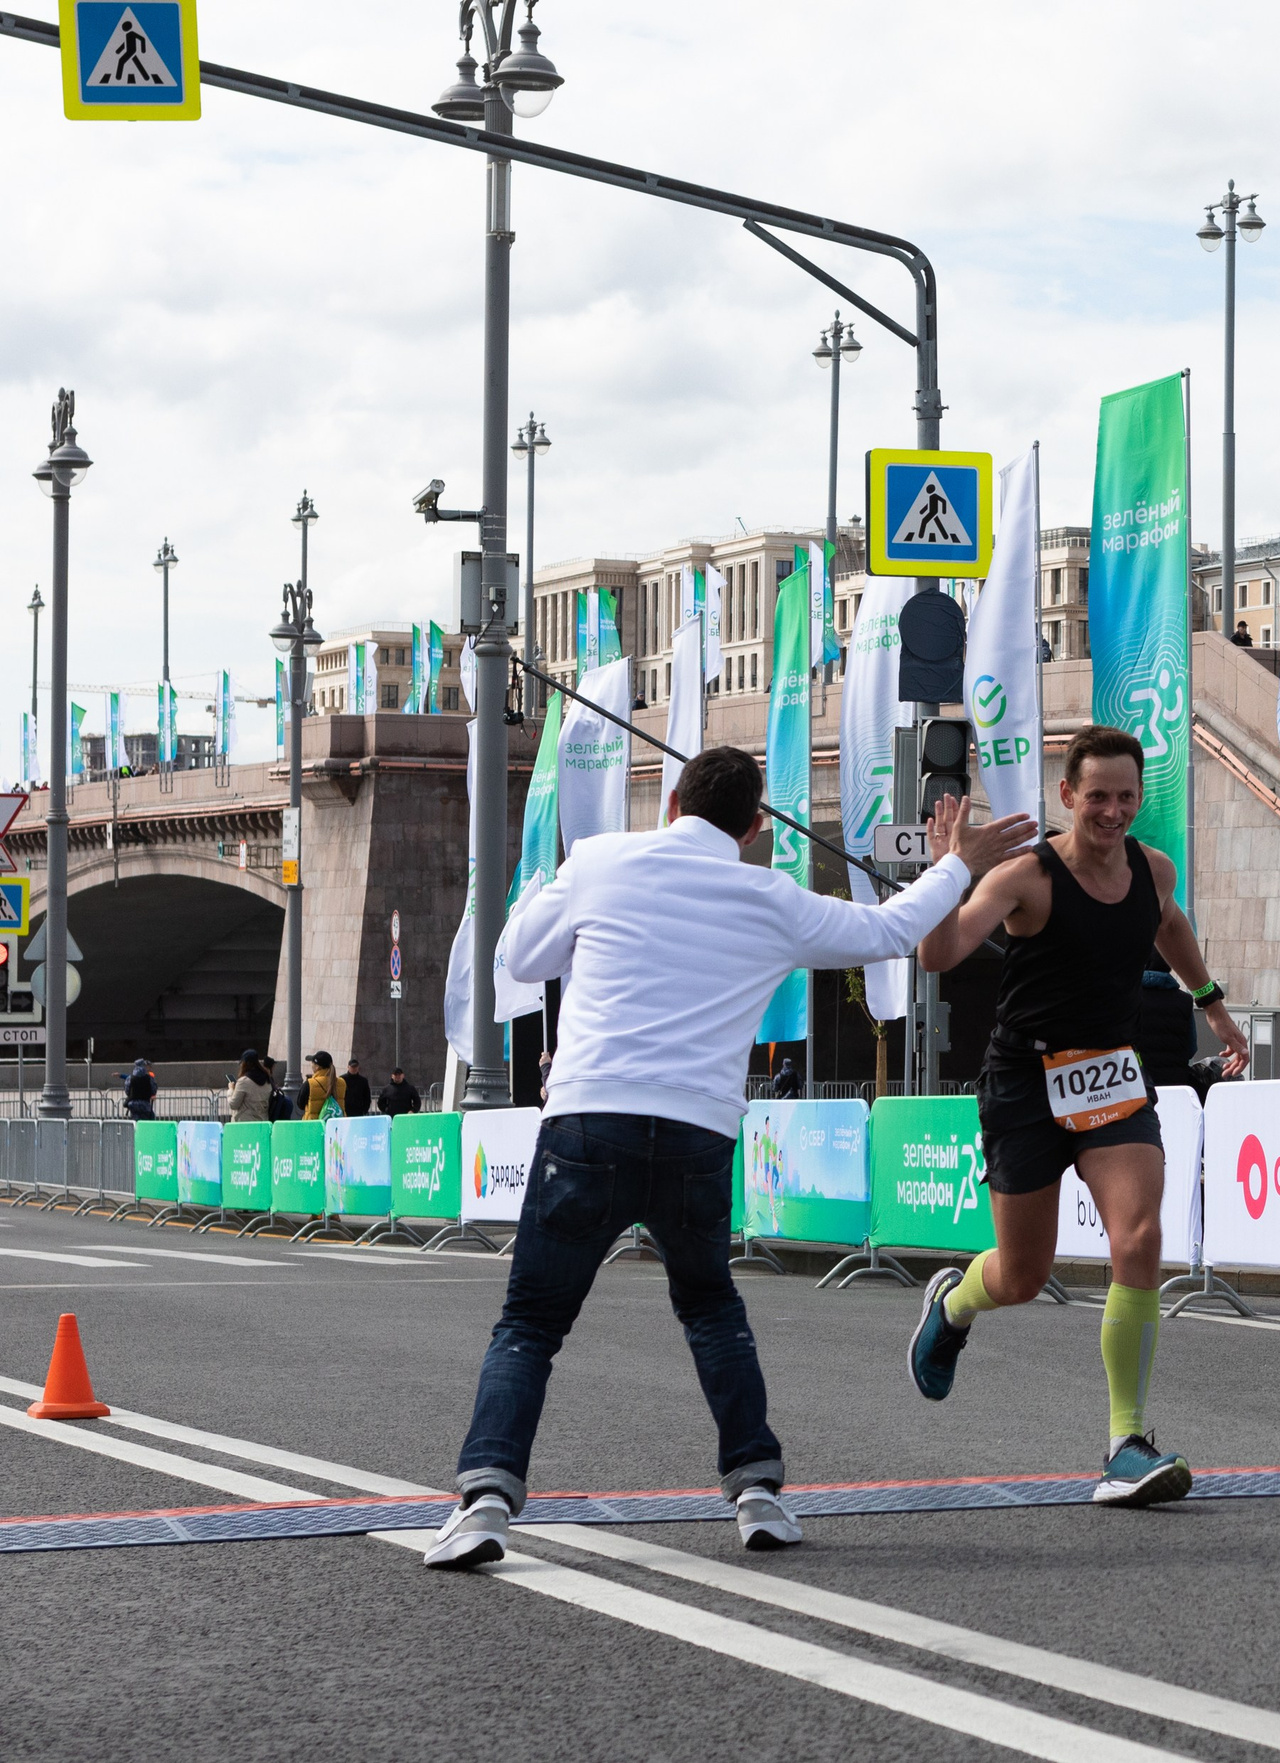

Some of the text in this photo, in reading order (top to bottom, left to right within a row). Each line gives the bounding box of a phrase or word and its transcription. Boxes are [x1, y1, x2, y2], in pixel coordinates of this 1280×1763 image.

[1102, 488, 1180, 531] зелёный
[1101, 518, 1179, 554] марафон
[565, 735, 624, 754] зелёный
[979, 737, 1030, 769] БЕР
[565, 755, 622, 772] марафон
[895, 831, 928, 856] СТ
[3, 1030, 38, 1041] СТОП
[1053, 1057, 1138, 1099] 10226
[1087, 1092, 1111, 1103] ИВАН
[405, 1139, 432, 1164] зелёный
[902, 1134, 959, 1169] зелёный
[402, 1164, 430, 1195] марафон
[490, 1163, 525, 1196] ЗАРЯДЬЕ
[896, 1171, 954, 1214] марафон
